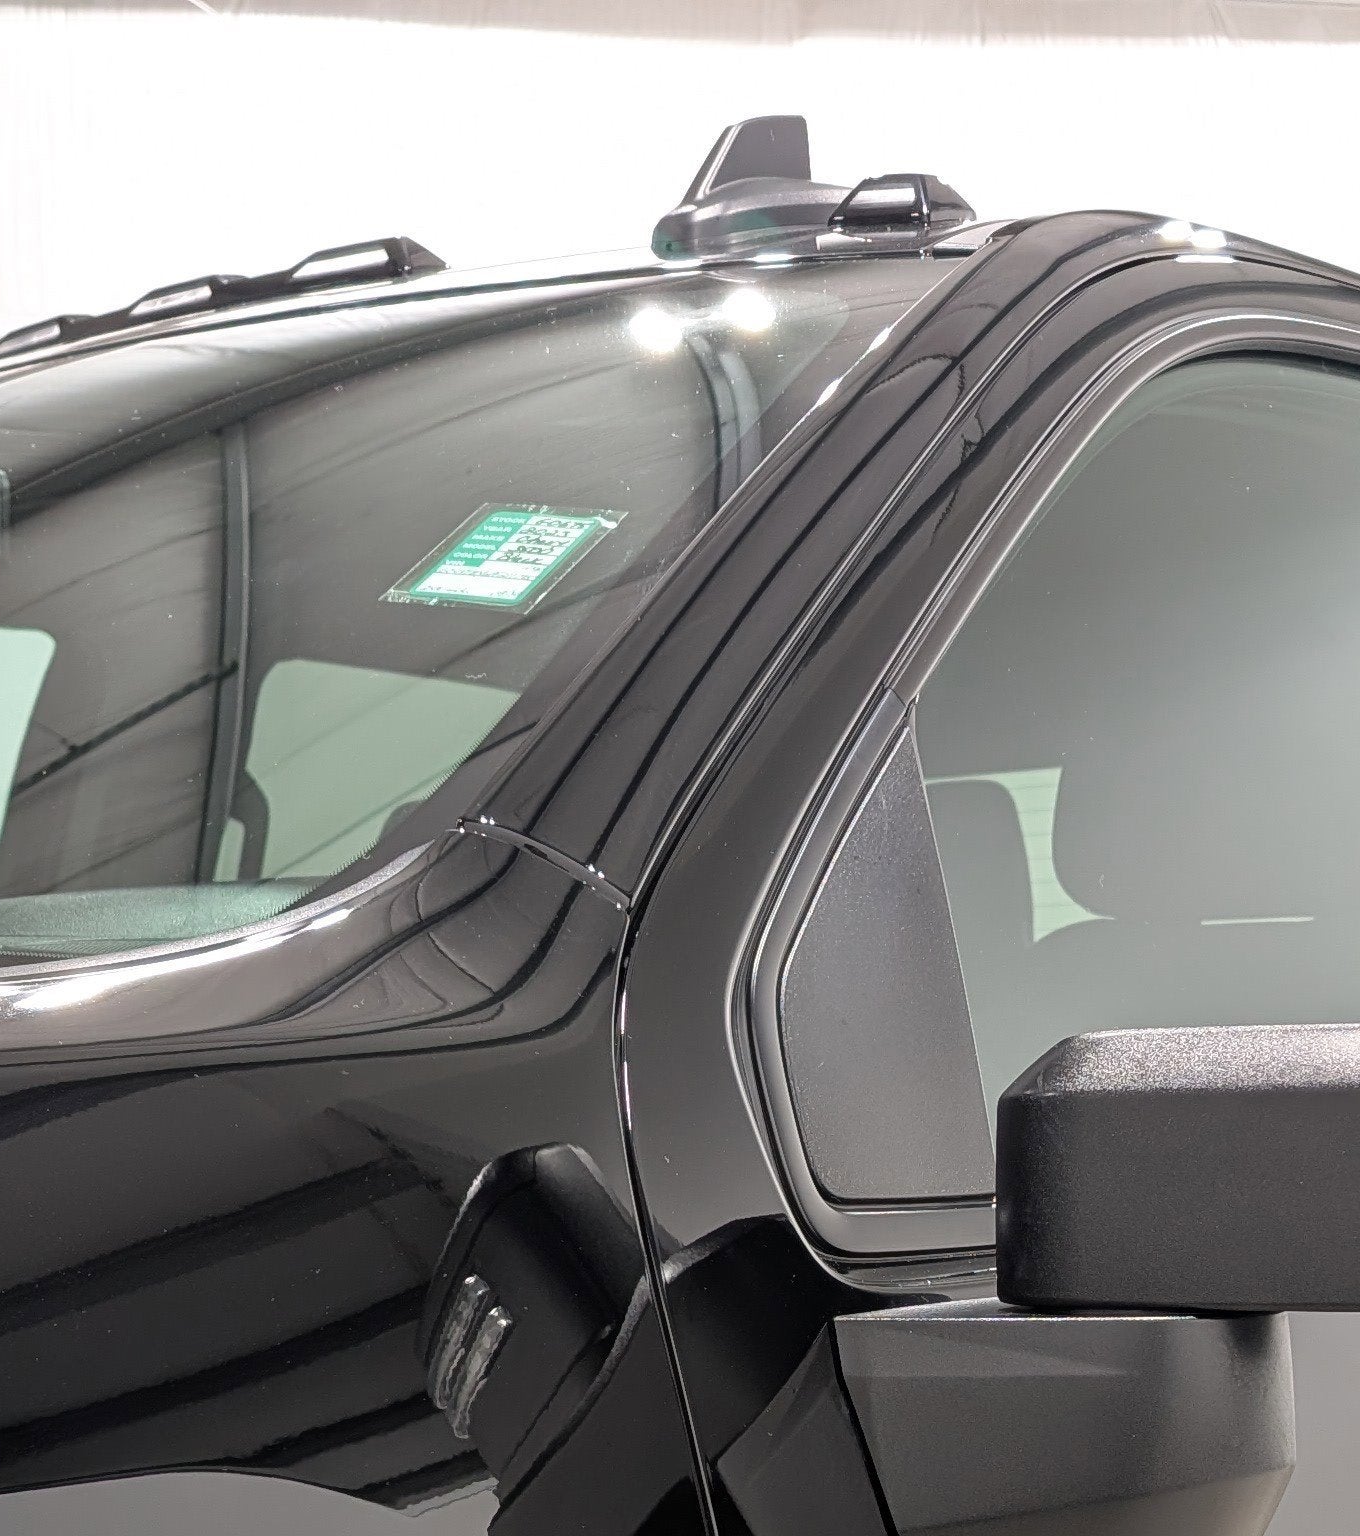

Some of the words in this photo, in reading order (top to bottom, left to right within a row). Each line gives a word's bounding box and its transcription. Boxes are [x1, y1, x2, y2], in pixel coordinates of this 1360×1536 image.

[483, 525, 513, 533] YEAR
[472, 534, 506, 542] MAKE
[463, 542, 497, 551] MODEL
[453, 551, 489, 560] COLOR
[445, 559, 466, 567] VIN
